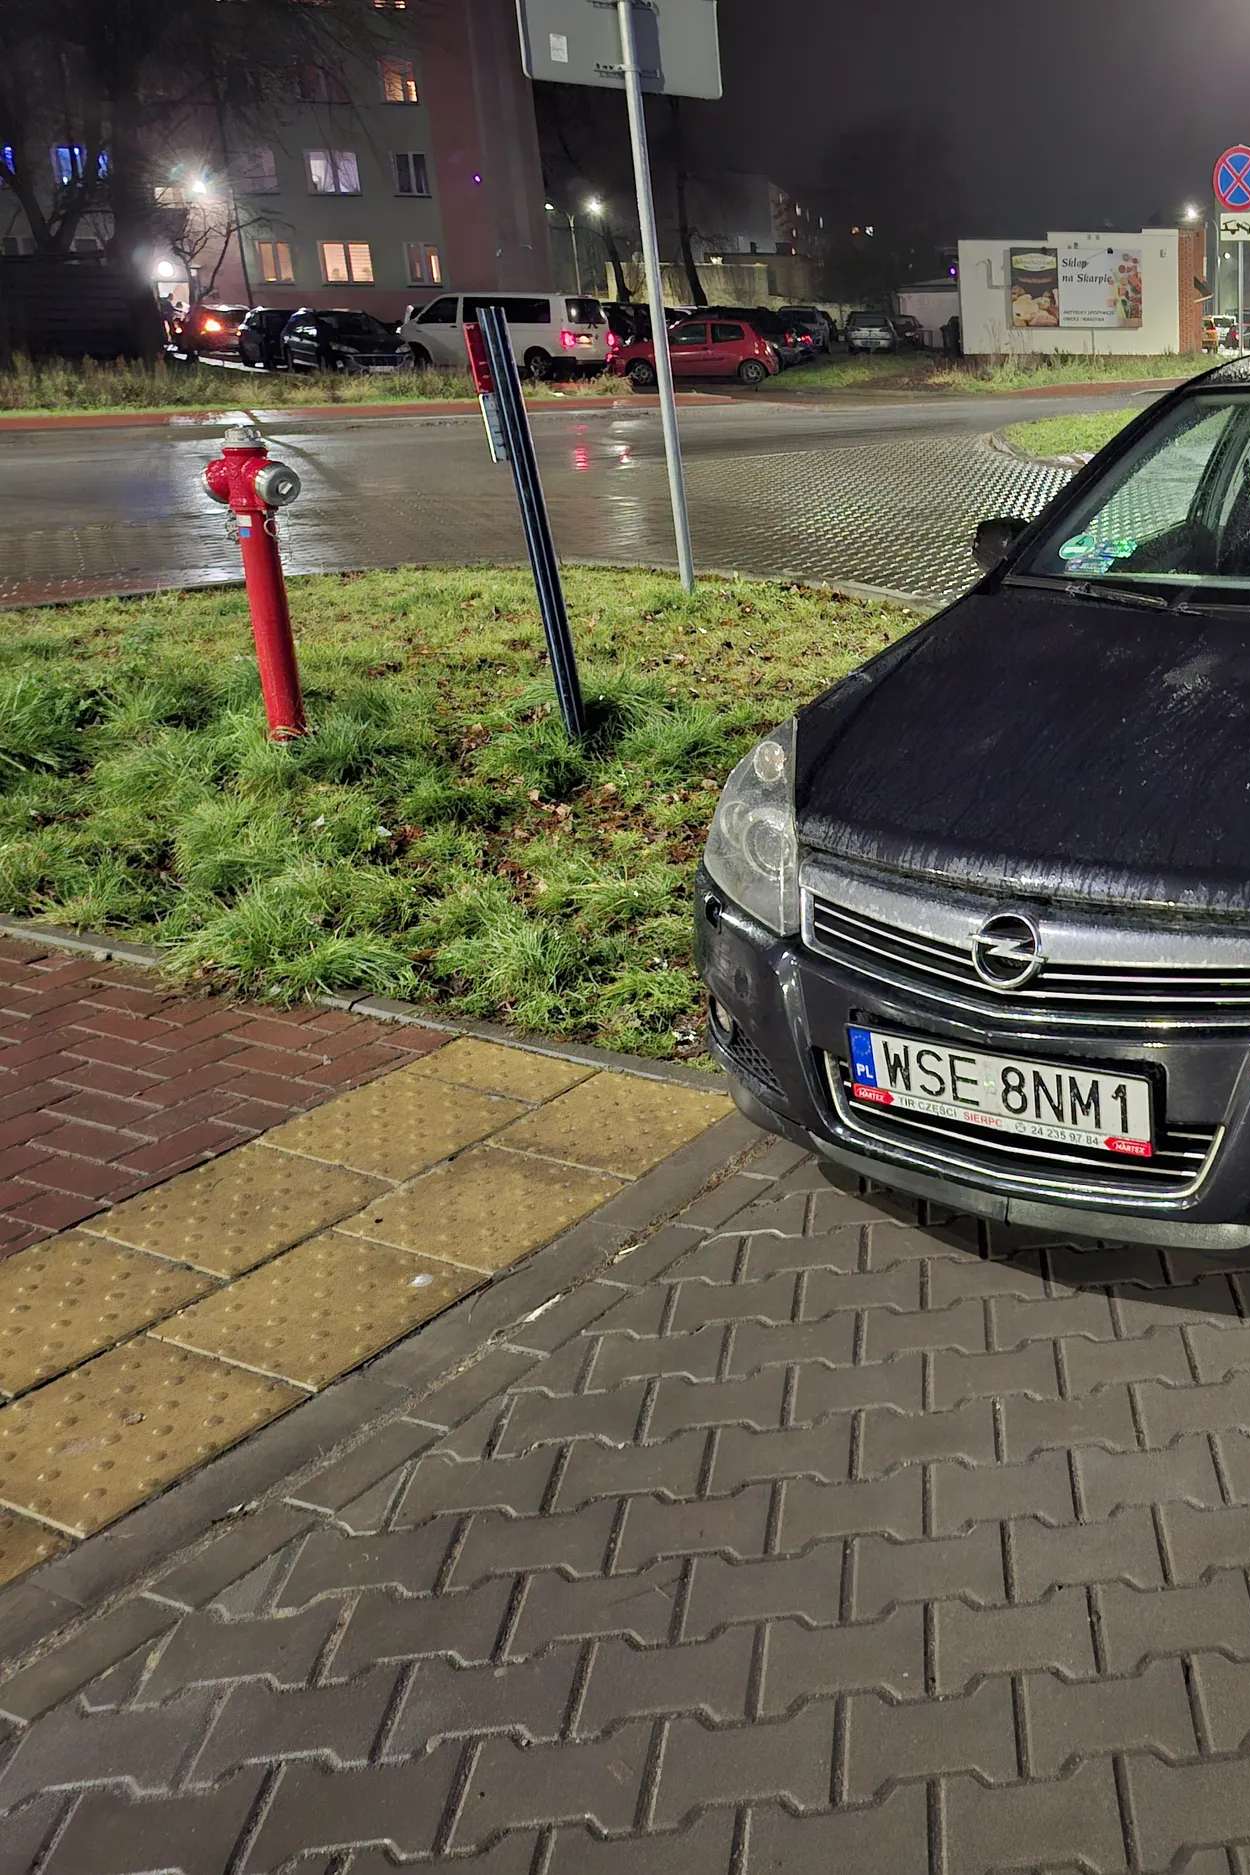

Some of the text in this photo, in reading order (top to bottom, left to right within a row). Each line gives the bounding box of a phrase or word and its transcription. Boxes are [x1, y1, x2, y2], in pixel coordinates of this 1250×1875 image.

[1061, 257, 1087, 270] Sklep
[1062, 274, 1074, 283] na
[1076, 273, 1113, 285] Skarpie
[856, 1063, 874, 1079] PL
[881, 1040, 1129, 1134] WSE 8NM1
[898, 1095, 916, 1108] TIR
[918, 1101, 957, 1118] CZĘŚCI
[963, 1111, 1003, 1128] SIERPC
[1031, 1125, 1044, 1136] 24
[1047, 1127, 1066, 1140] 235
[1086, 1135, 1099, 1146] 84
